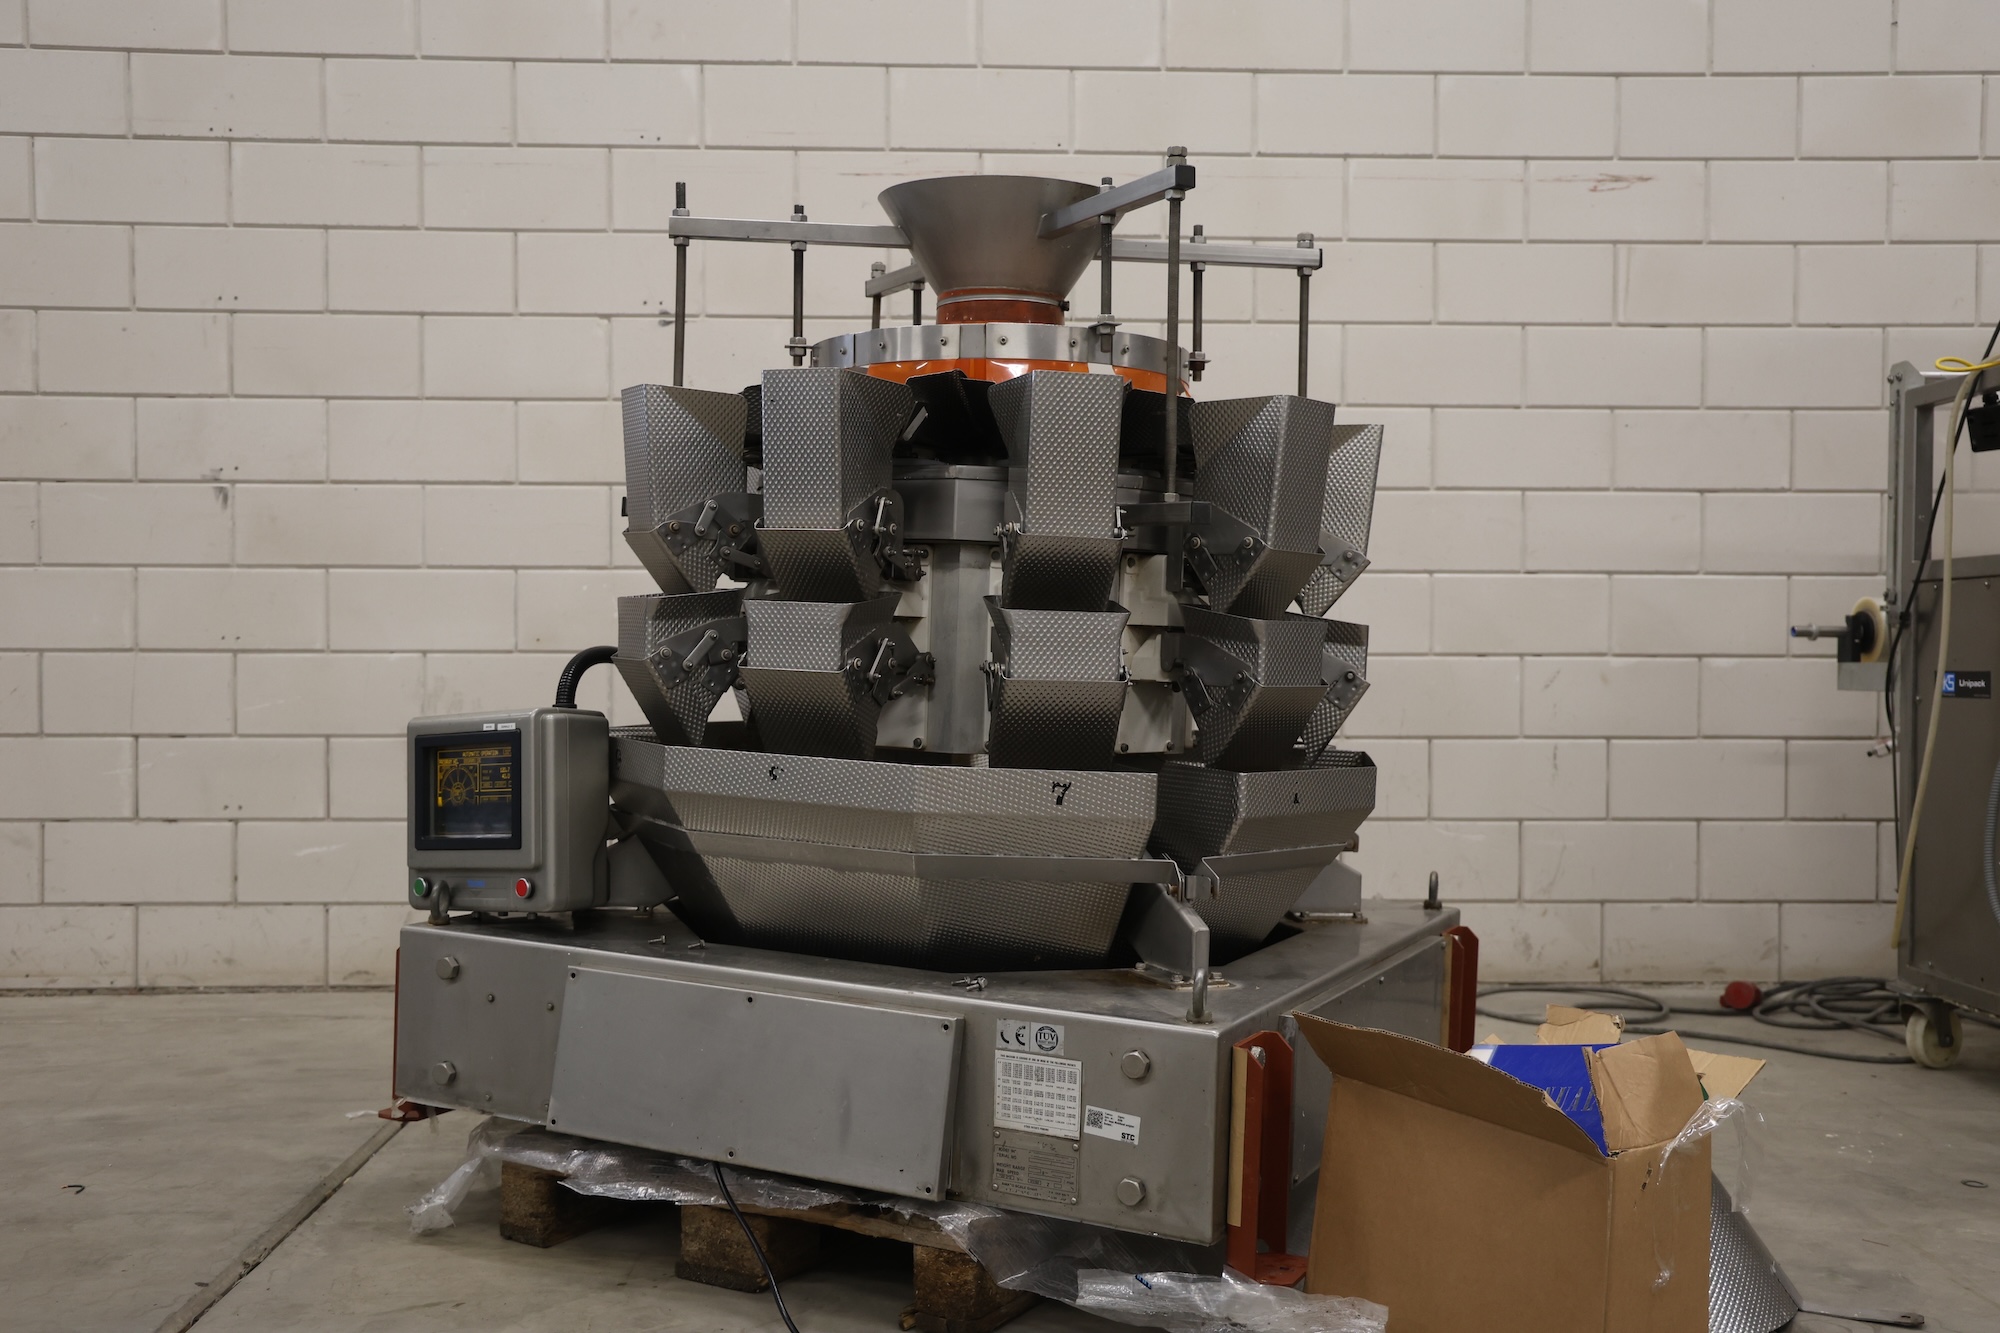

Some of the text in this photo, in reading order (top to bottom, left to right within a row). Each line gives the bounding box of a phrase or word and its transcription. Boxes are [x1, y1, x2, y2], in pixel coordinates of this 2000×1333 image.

[1959, 679, 1986, 689] Unipack
[1052, 781, 1072, 805] 7
[1121, 1132, 1135, 1141] STC
